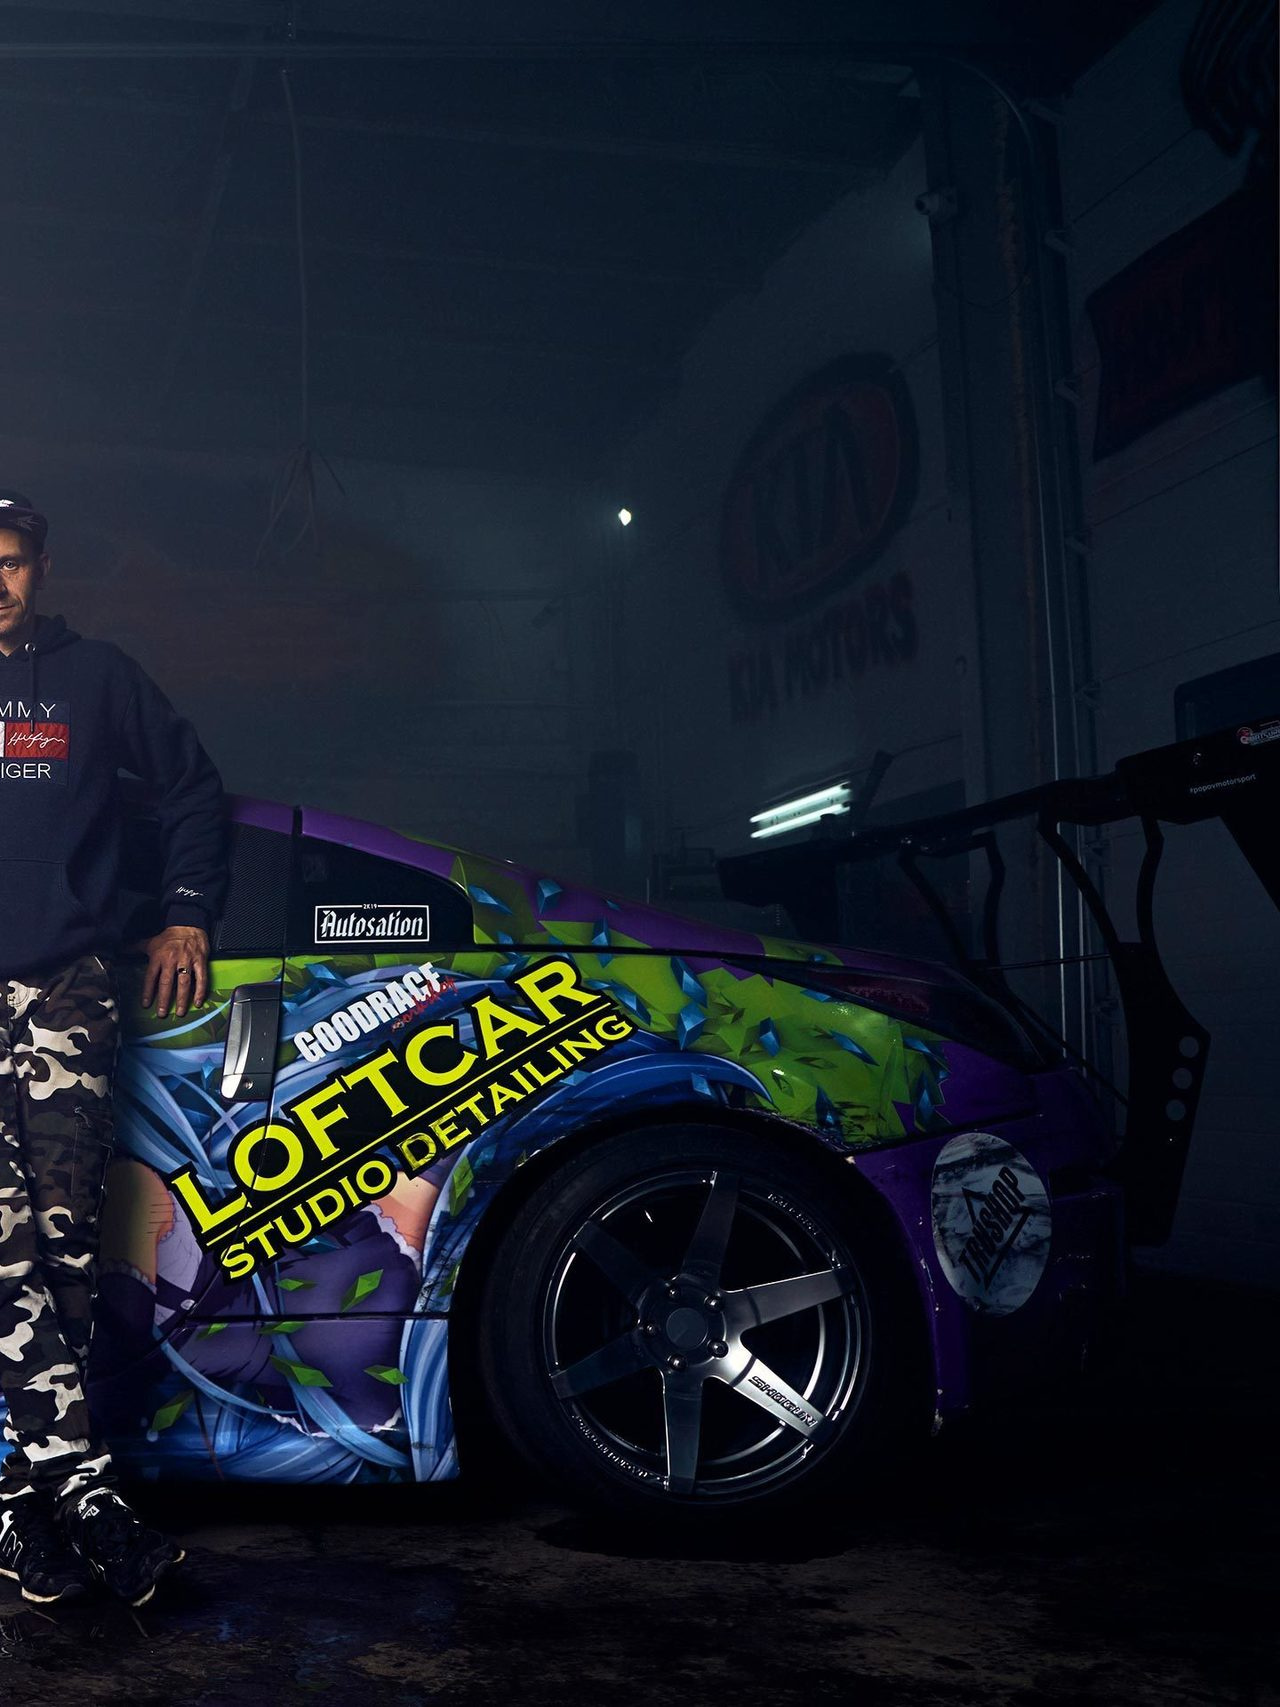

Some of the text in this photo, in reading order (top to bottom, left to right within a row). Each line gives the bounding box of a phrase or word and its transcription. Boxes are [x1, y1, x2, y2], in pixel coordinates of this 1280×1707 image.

[320, 910, 424, 938] Autosation
[171, 960, 601, 1234] LOFTCAR
[220, 1013, 634, 1280] STUDIO DETAILING
